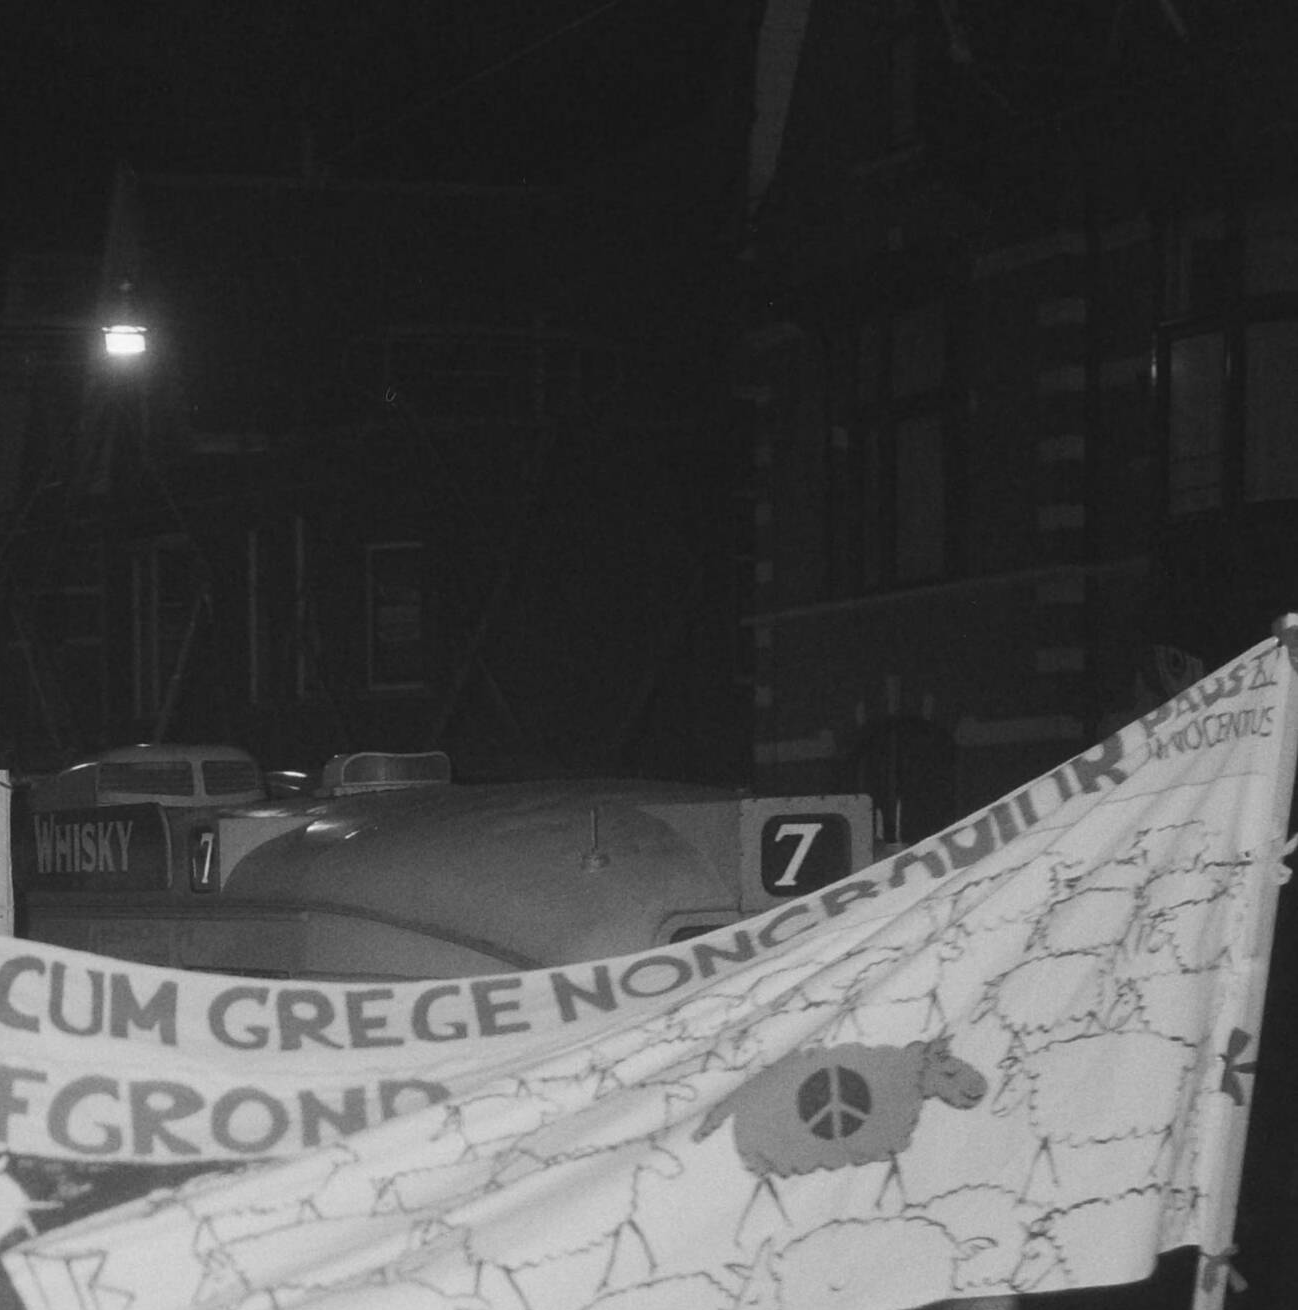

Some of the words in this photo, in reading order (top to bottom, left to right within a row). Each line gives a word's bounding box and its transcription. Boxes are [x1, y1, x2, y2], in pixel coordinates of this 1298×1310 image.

[33, 812, 132, 874] WHISKY
[774, 823, 823, 886] 7
[208, 977, 532, 1051] GREGE
